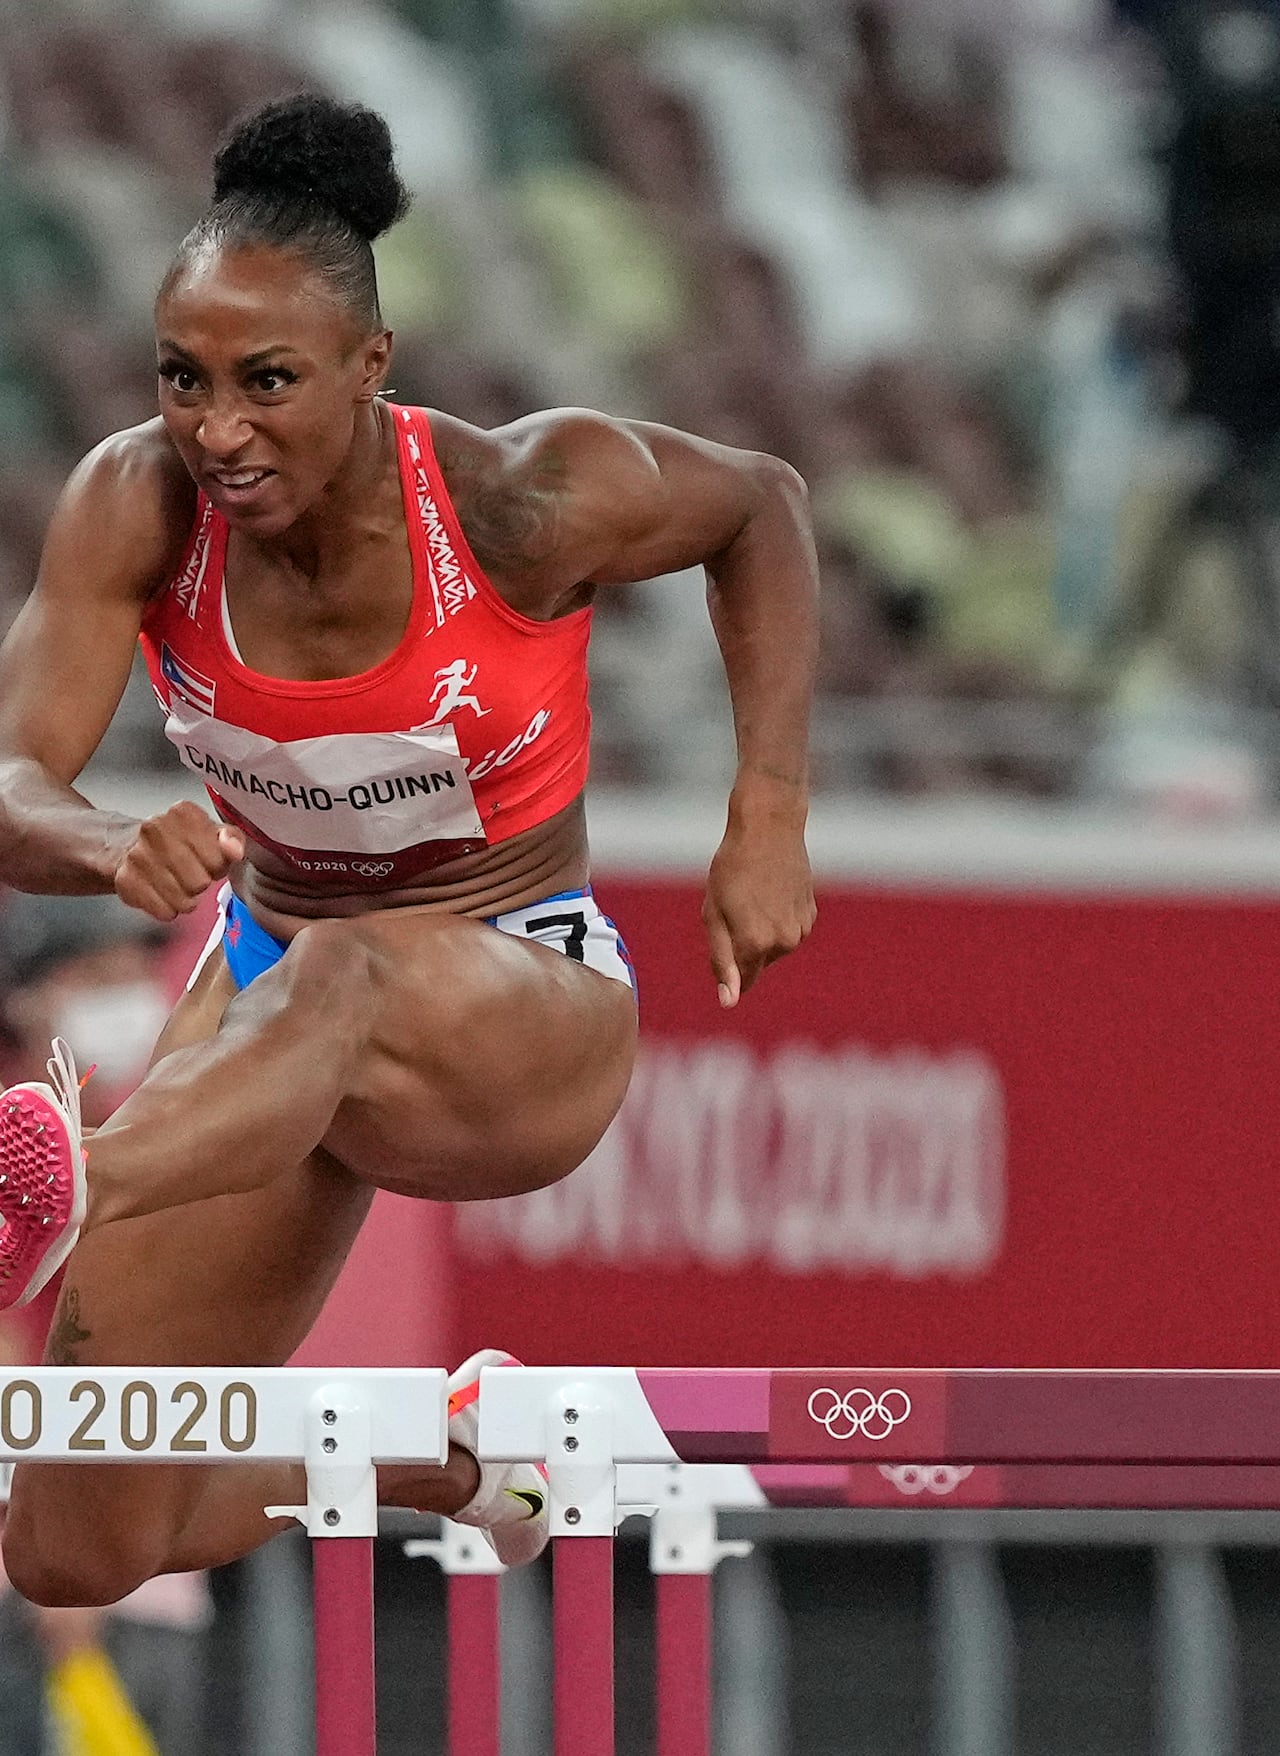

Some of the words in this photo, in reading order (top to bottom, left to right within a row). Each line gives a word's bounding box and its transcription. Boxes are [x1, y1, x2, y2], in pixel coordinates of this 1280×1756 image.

[184, 744, 457, 811] CAMACHO-QUINN
[461, 709, 551, 781] ico
[313, 861, 348, 873] 2020
[525, 911, 587, 963] 7
[68, 1380, 257, 1453] 2020
